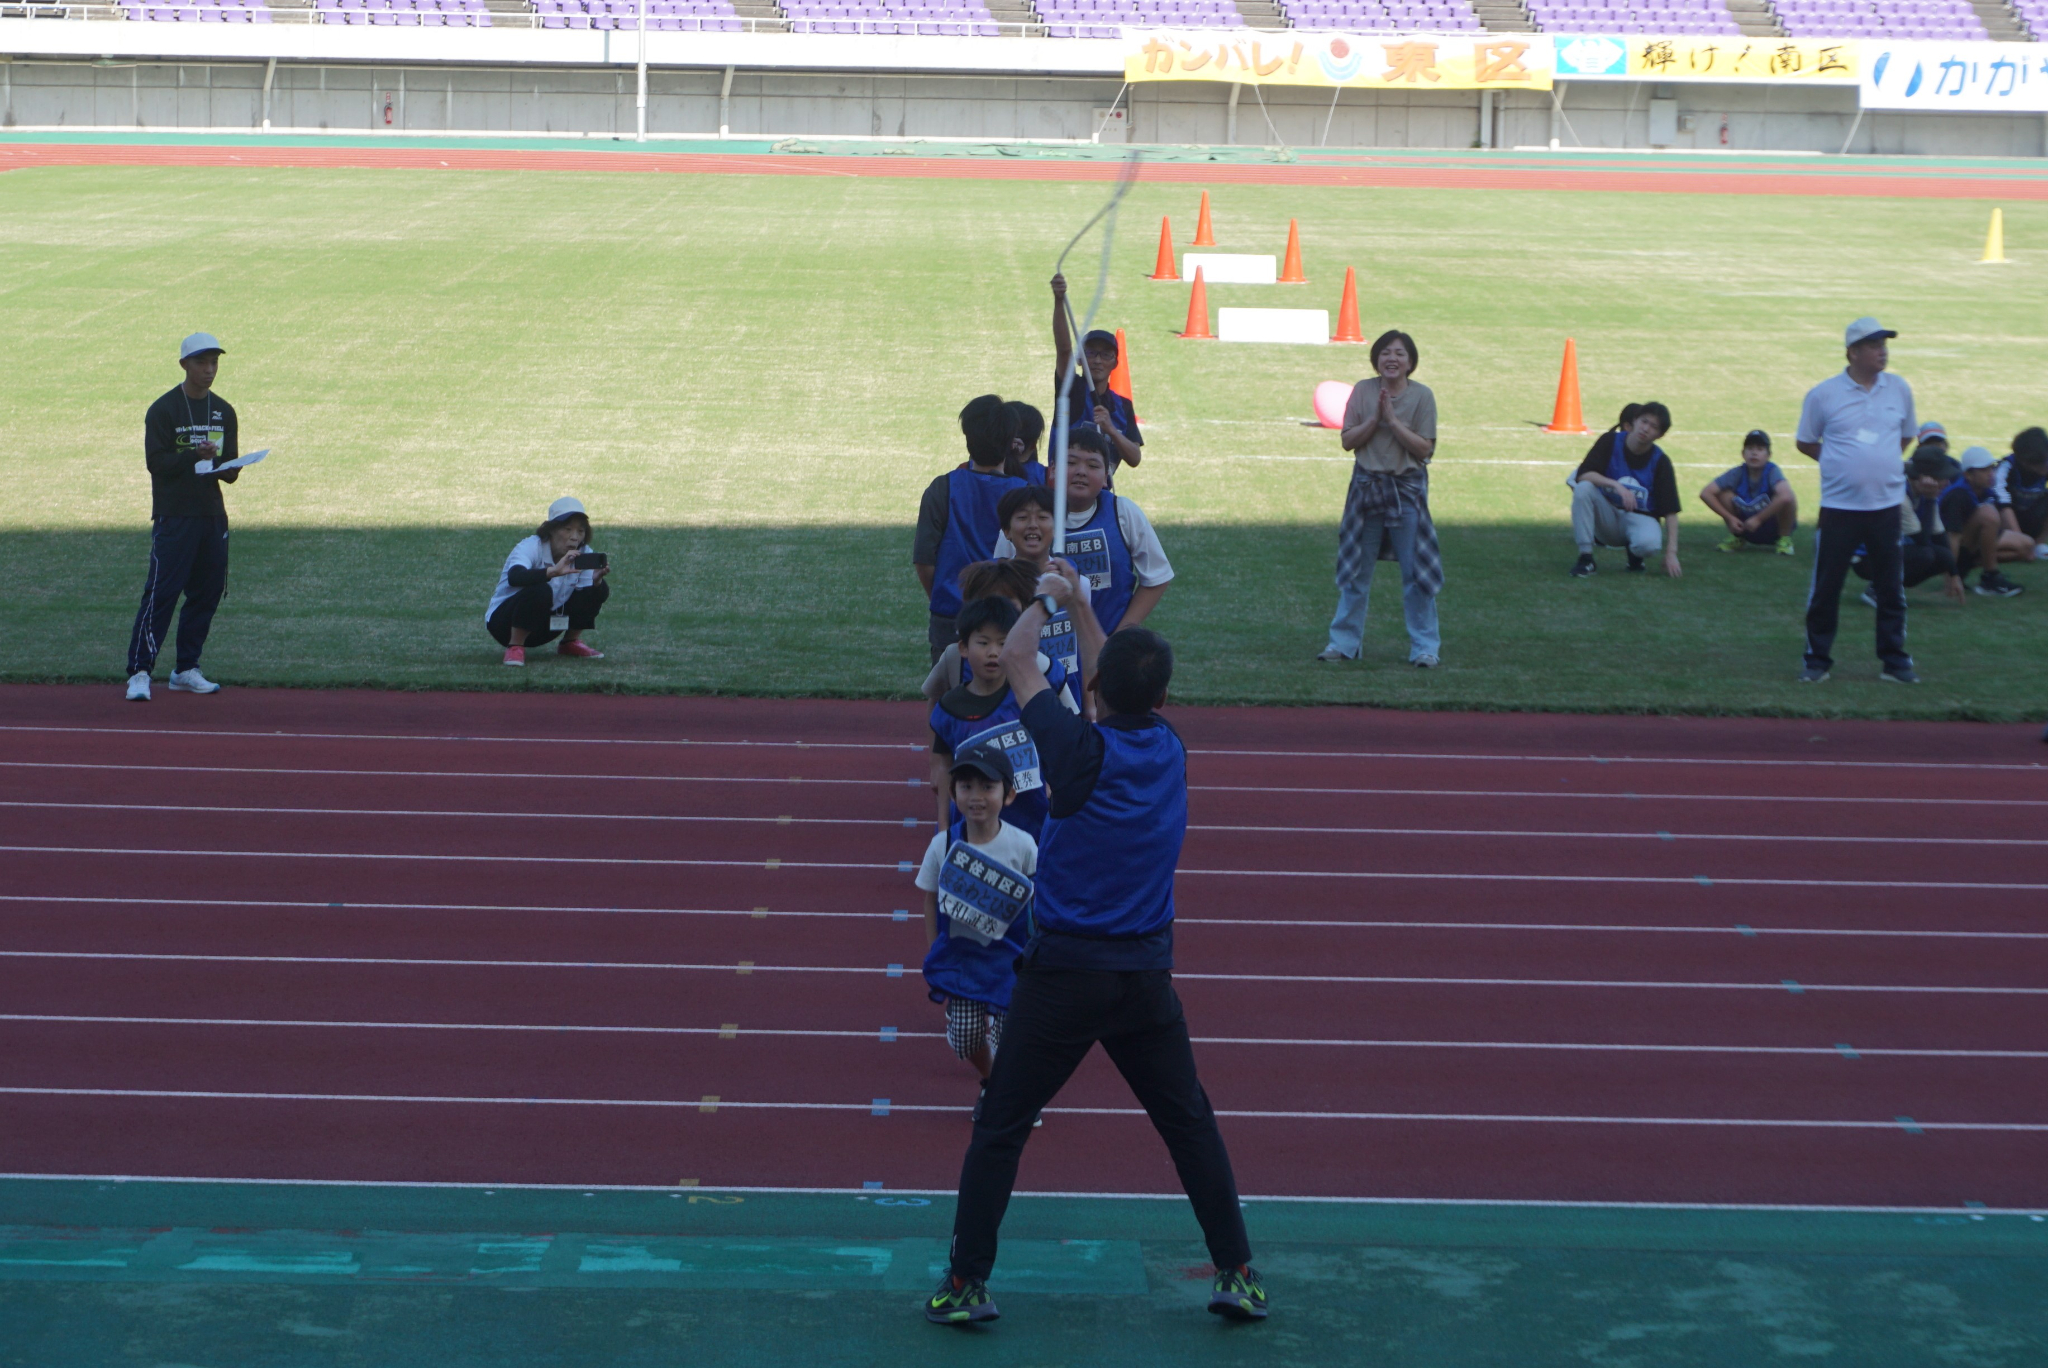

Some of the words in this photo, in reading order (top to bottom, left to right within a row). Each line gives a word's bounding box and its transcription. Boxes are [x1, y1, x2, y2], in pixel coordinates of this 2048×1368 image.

[1380, 41, 1532, 82] 東区
[1935, 54, 2048, 96] かが
[953, 850, 1026, 900] 安佐南区B
[940, 893, 998, 934] 大和証券
